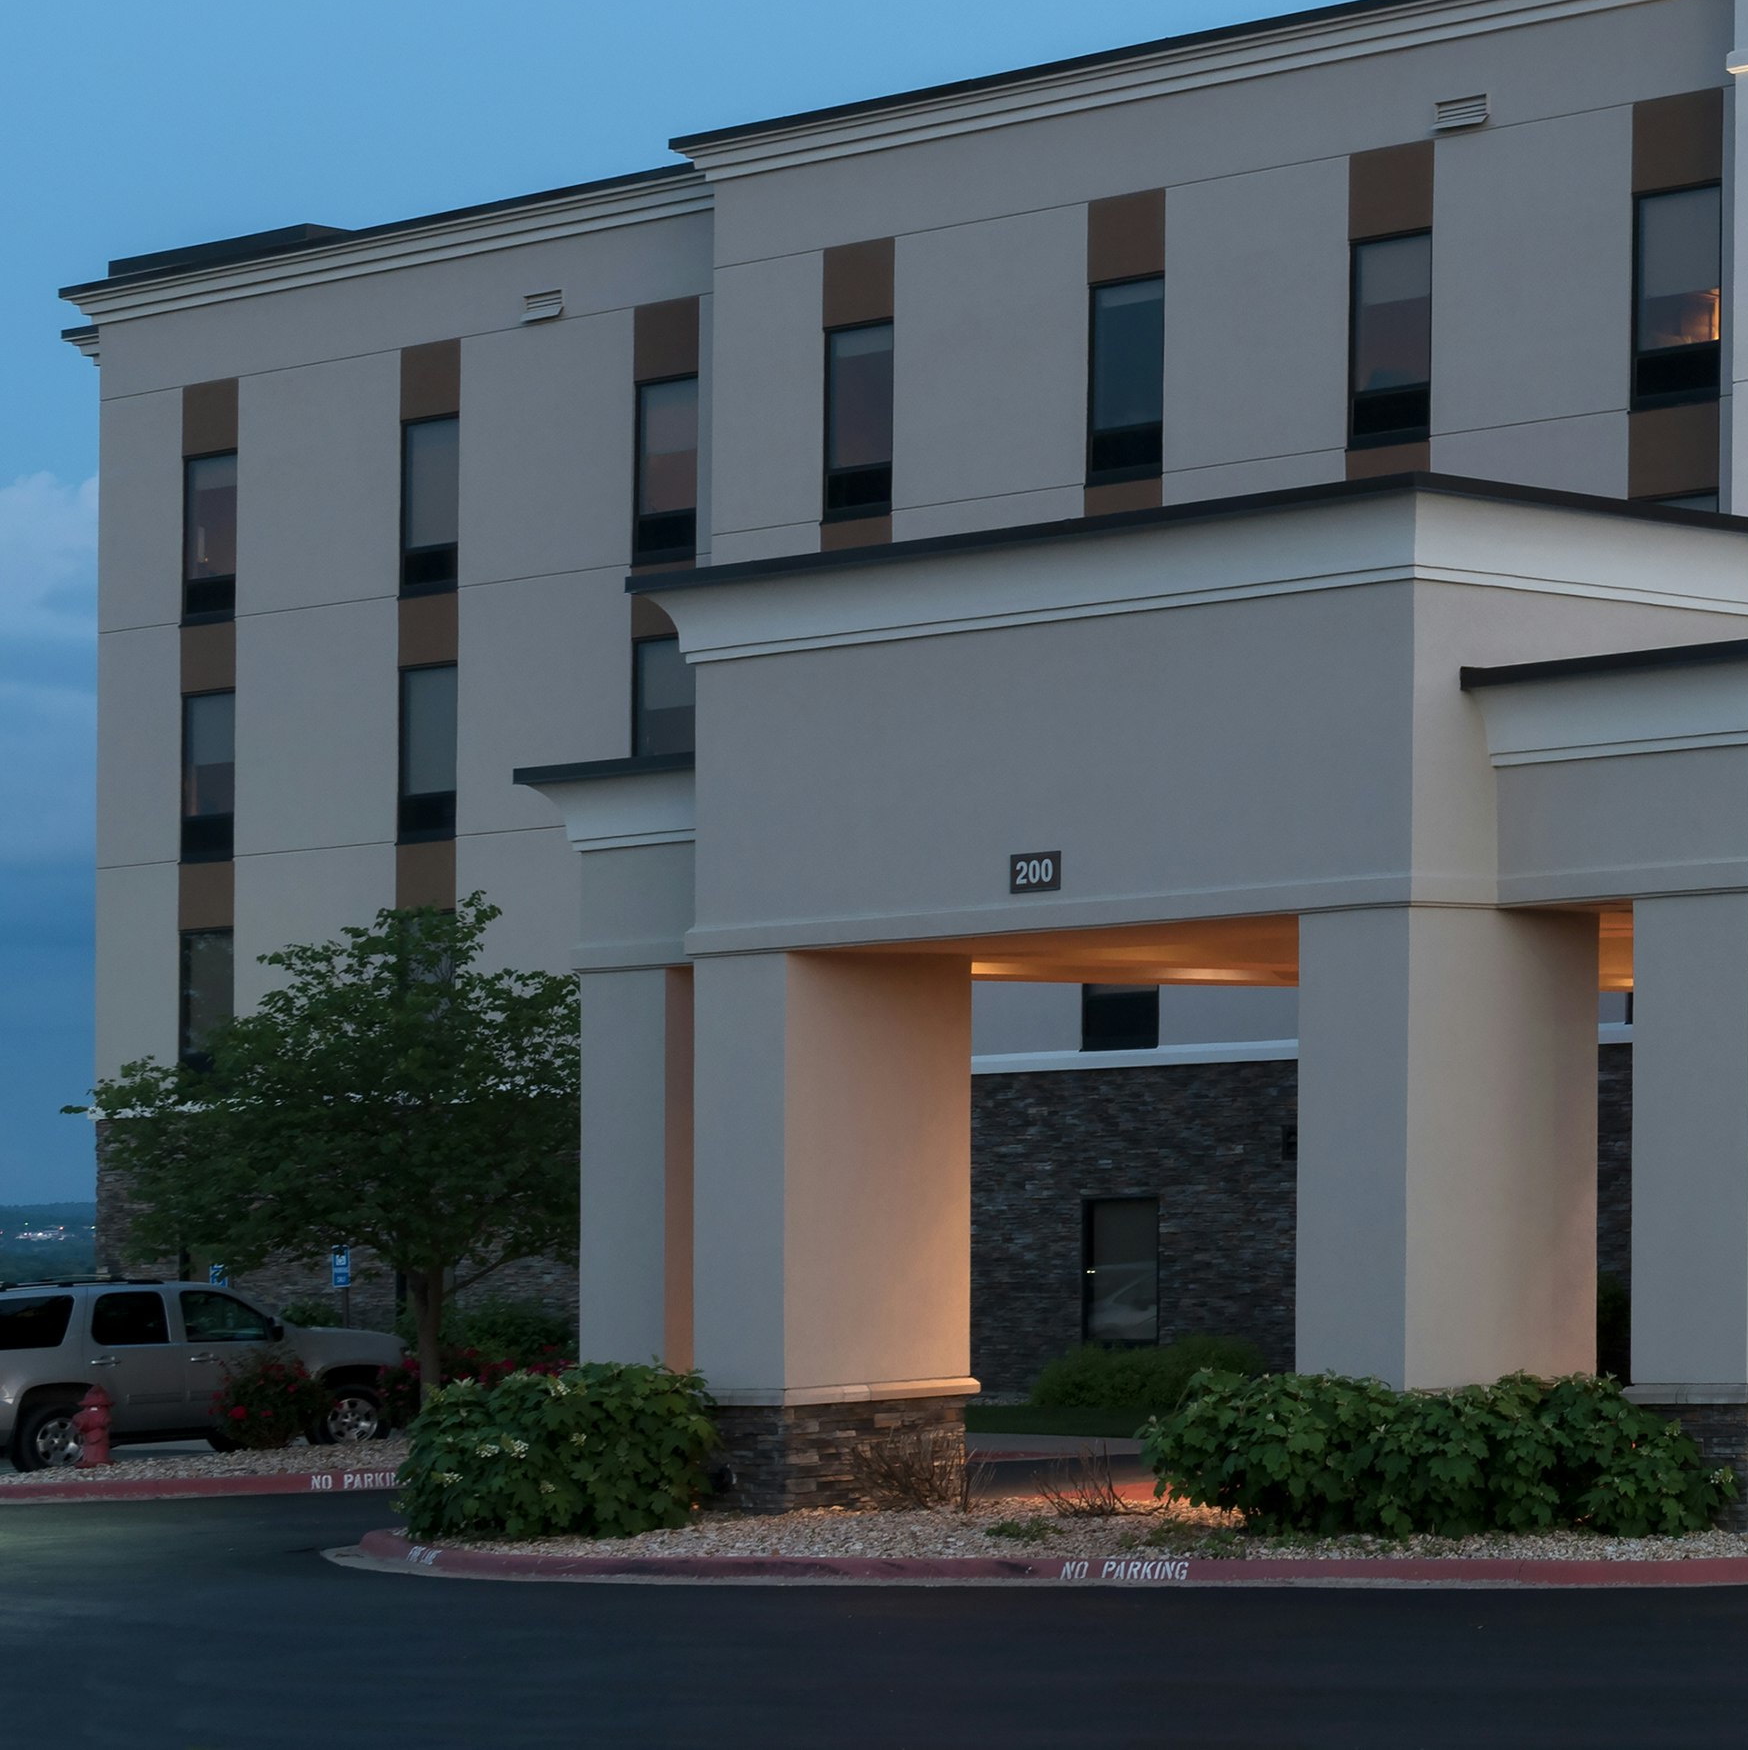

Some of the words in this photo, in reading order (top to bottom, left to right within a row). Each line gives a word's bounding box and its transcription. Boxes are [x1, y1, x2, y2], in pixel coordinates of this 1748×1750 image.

[1015, 858, 1054, 885] 200
[311, 1474, 333, 1491] NO
[343, 1471, 399, 1490] PARKIN
[1060, 1561, 1089, 1581] NO
[1101, 1561, 1190, 1581] PARKING
